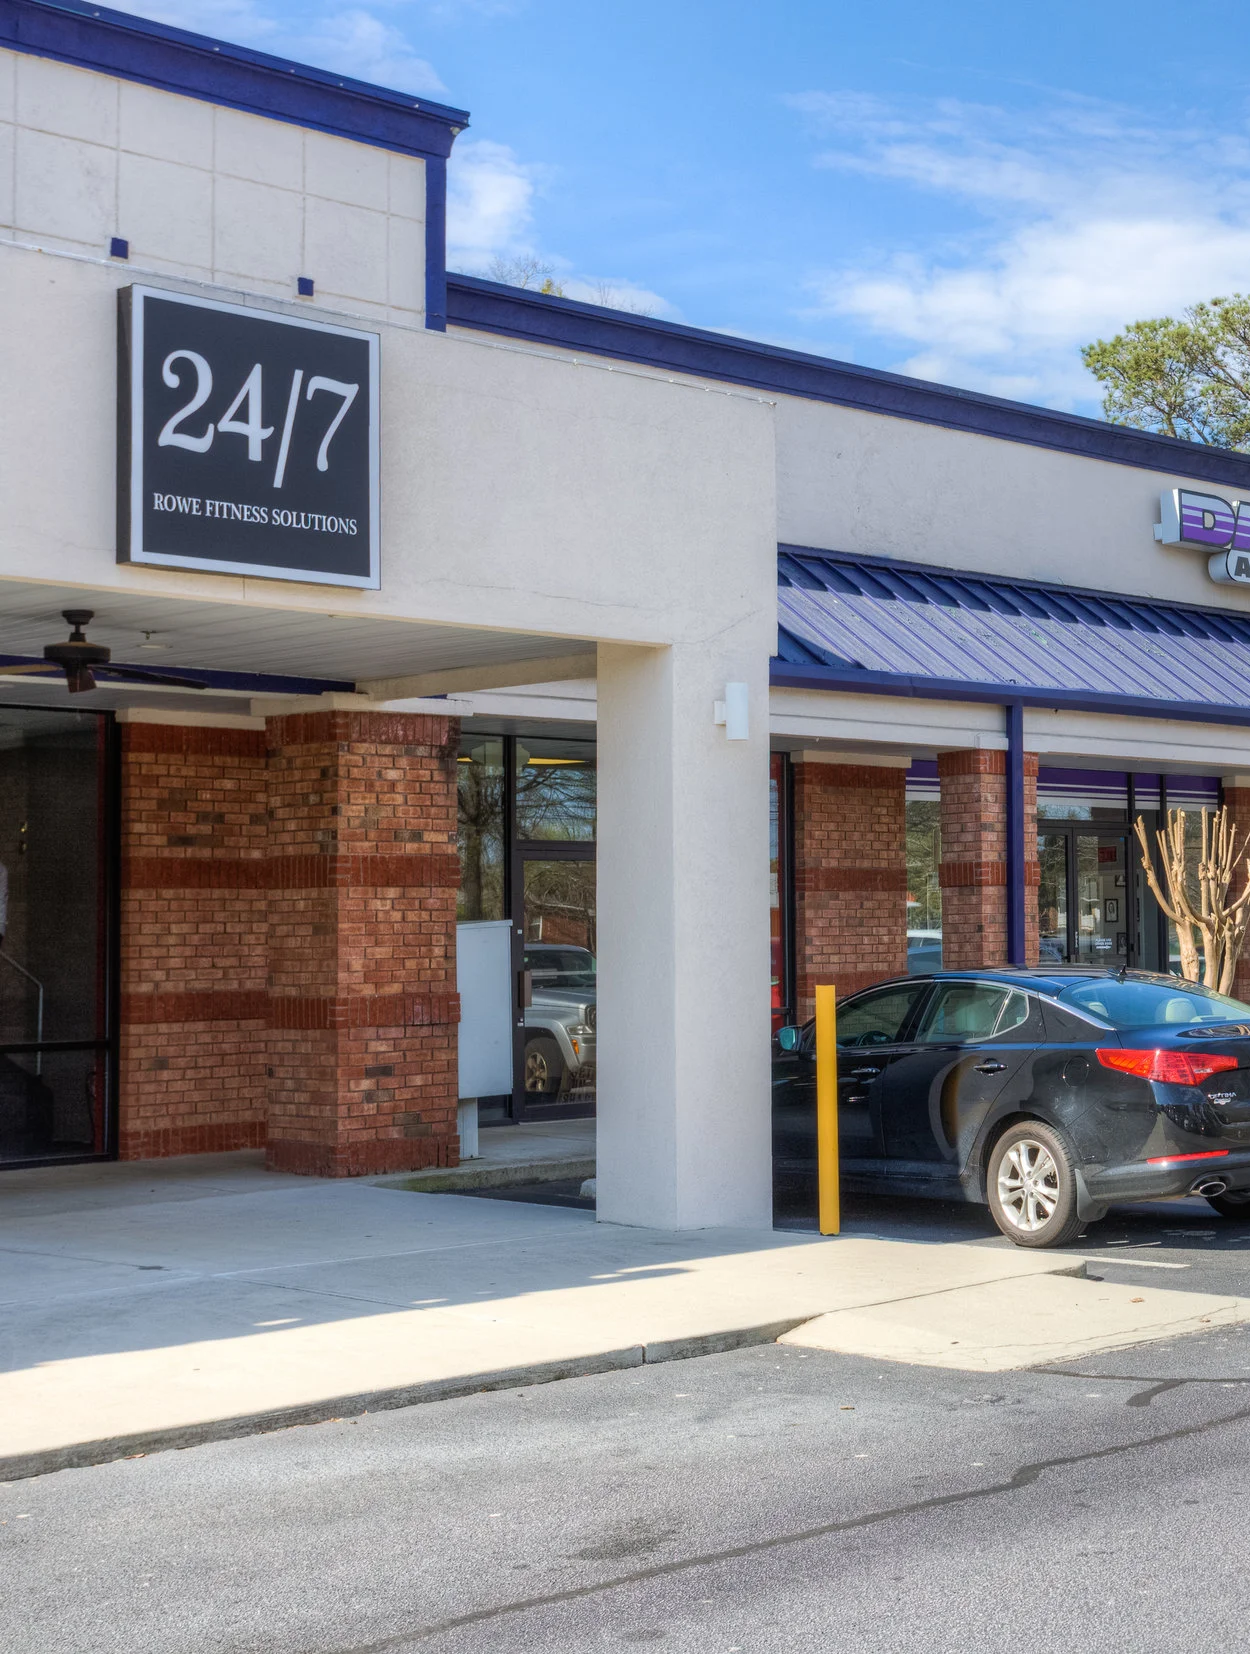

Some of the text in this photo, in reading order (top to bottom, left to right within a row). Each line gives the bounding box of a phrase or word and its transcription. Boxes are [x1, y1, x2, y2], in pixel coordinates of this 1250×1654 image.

[158, 349, 360, 489] 24/7
[153, 492, 358, 536] ROWE FITNESS SOLUTIONS
